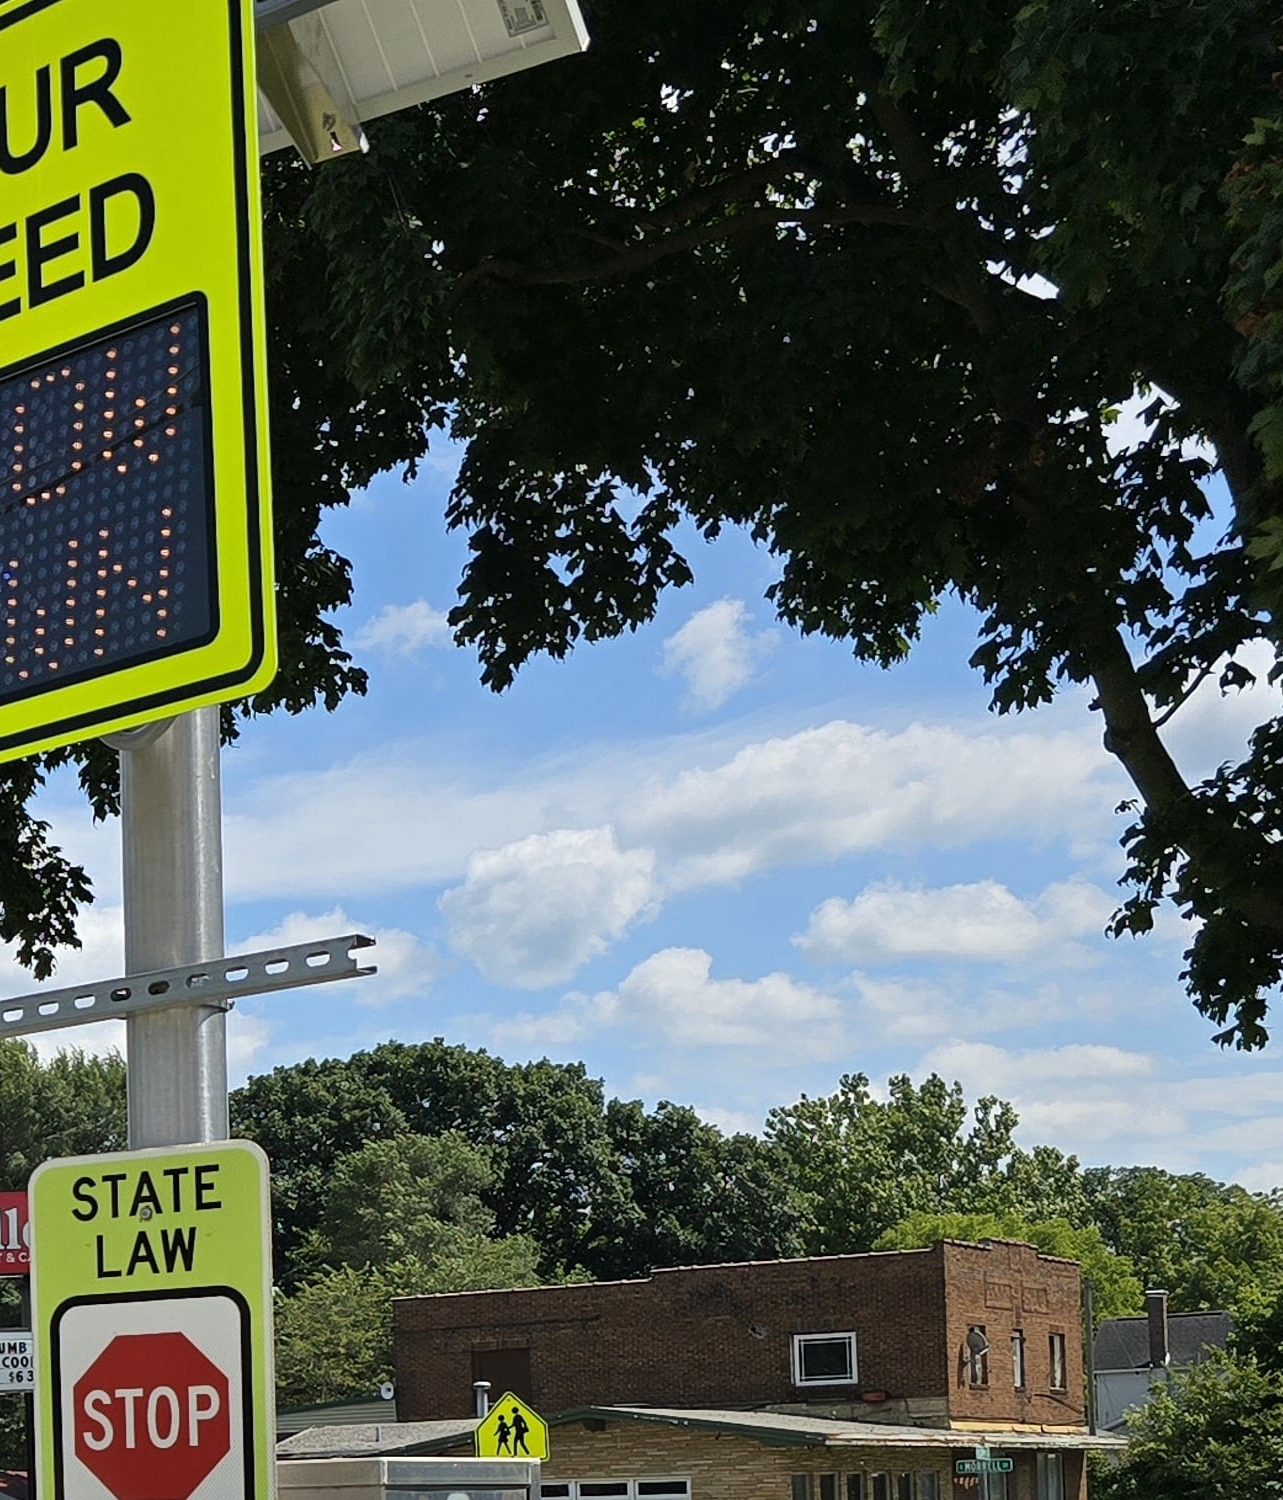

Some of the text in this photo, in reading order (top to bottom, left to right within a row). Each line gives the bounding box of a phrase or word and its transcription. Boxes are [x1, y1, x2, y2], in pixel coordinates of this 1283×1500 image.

[71, 1164, 222, 1222] STATE
[6, 1252, 15, 1263] &
[18, 1252, 32, 1263] C
[97, 1227, 197, 1279] LAW
[83, 1384, 221, 1451] STOP
